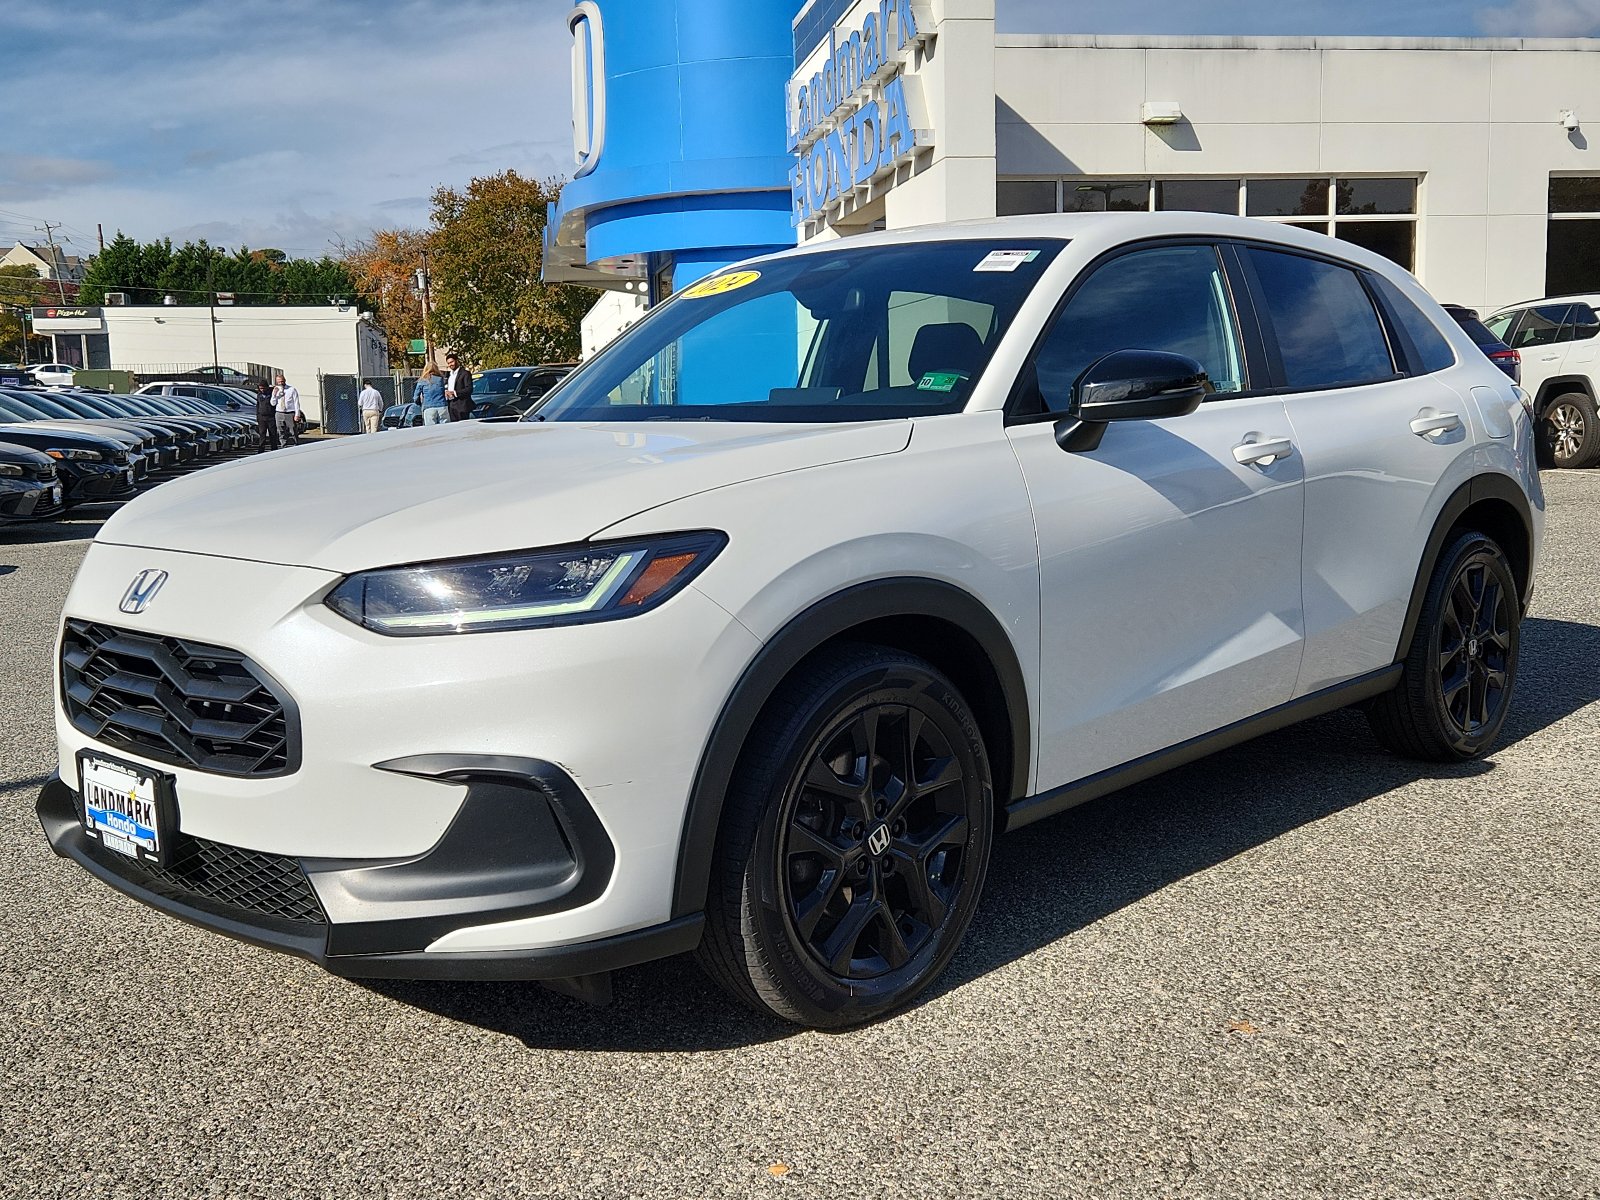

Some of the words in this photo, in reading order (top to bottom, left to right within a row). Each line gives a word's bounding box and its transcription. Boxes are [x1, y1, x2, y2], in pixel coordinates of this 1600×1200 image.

[785, 0, 917, 153] Landmark
[788, 75, 915, 227] HONDA
[56, 309, 74, 317] Pizza
[920, 378, 932, 386] 10
[87, 782, 153, 827] LANDMARK
[106, 812, 137, 836] Honda
